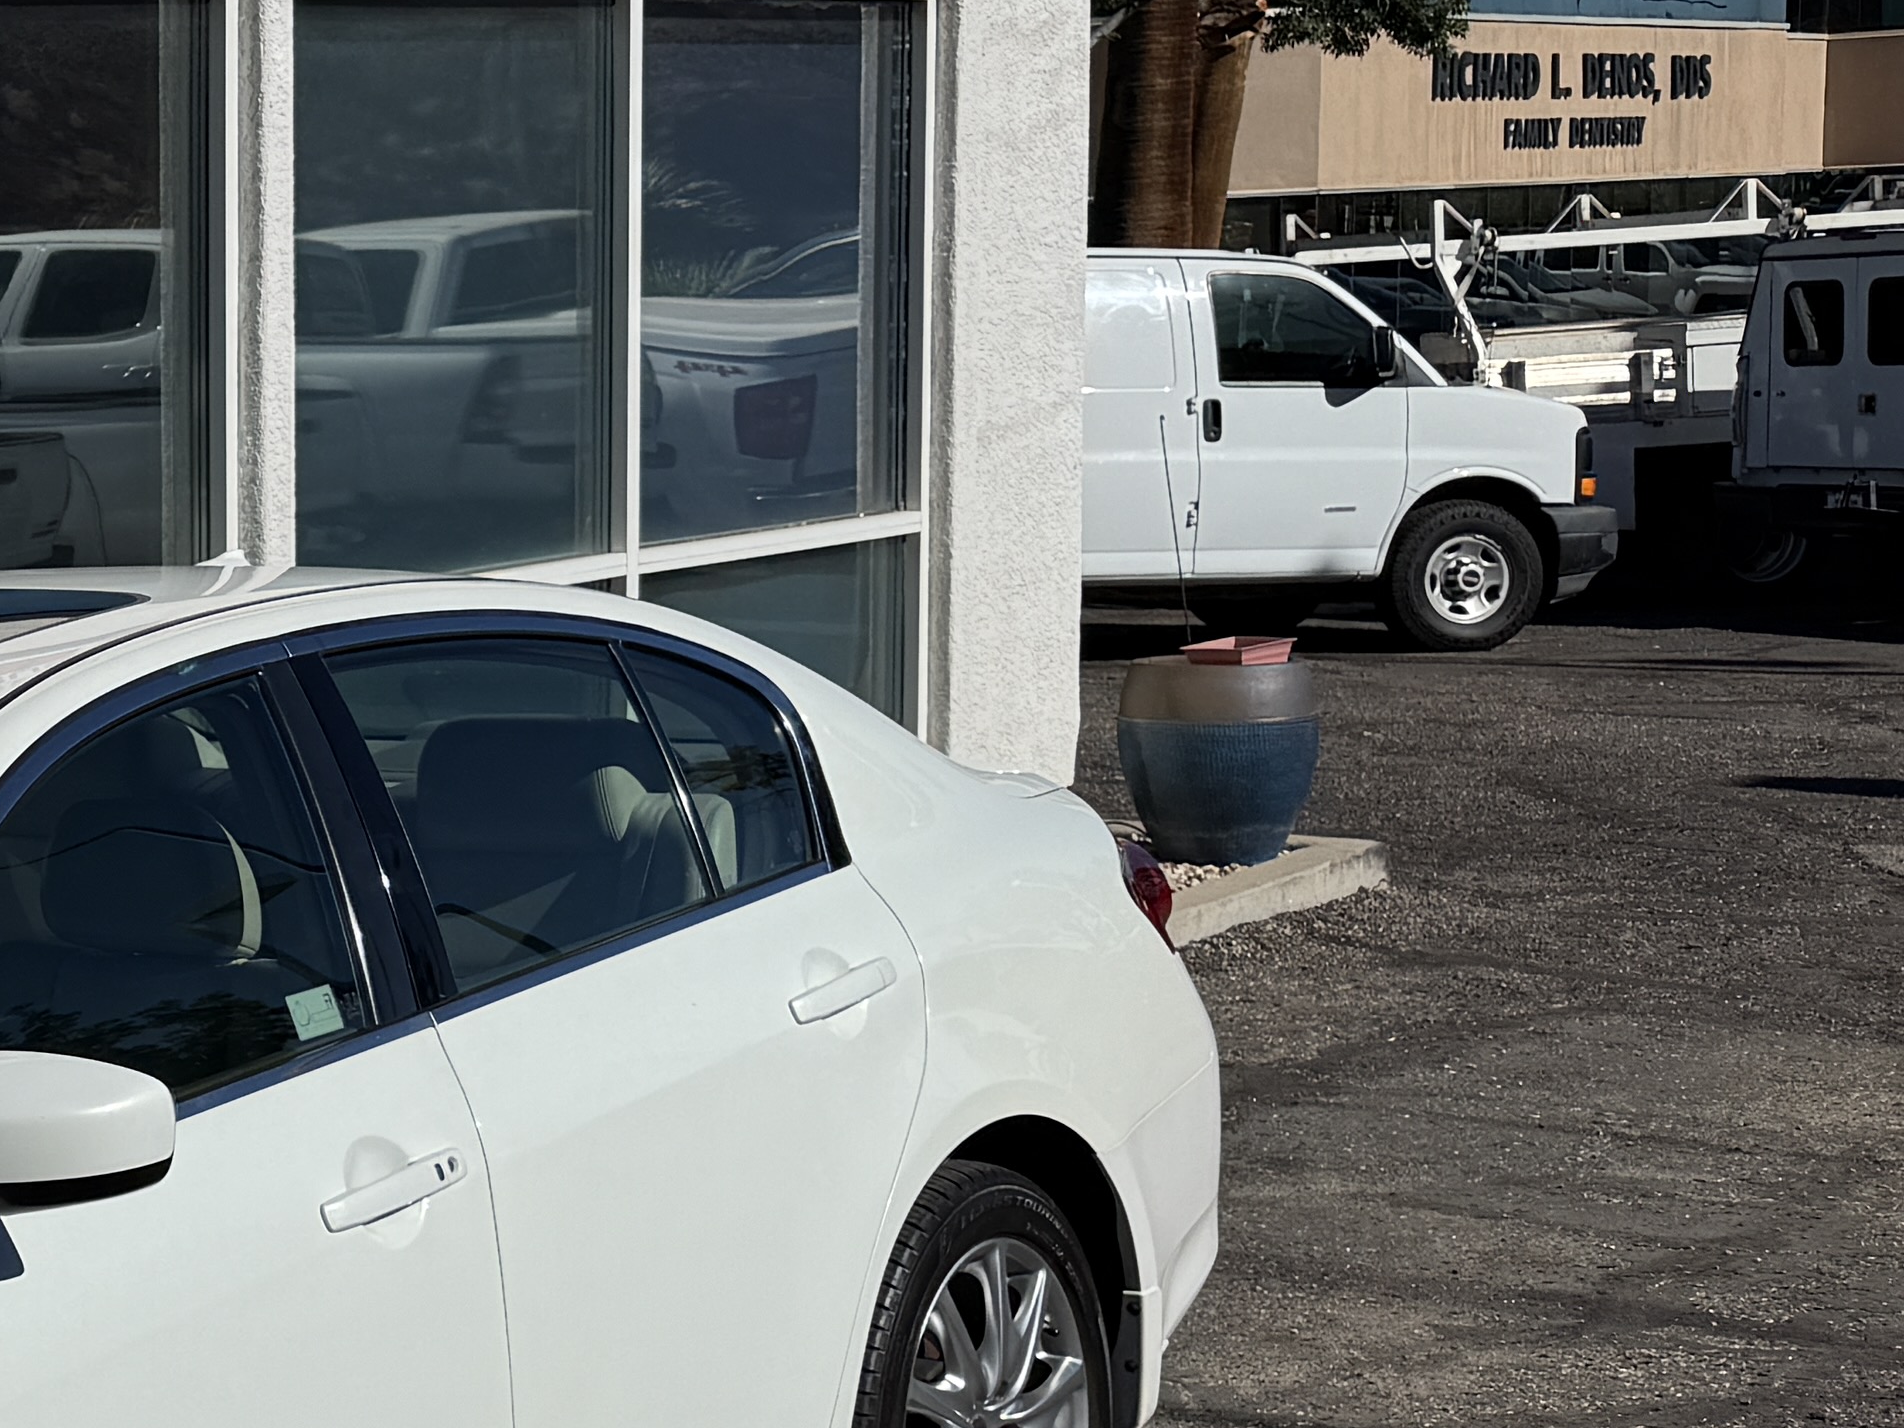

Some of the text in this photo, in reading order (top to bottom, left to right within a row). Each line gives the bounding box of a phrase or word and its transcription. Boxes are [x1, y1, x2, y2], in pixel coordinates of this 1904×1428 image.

[1431, 50, 1713, 106] RICHARD L. DENOS, DDS
[1503, 115, 1647, 151] FAMILY DENTISTRY
